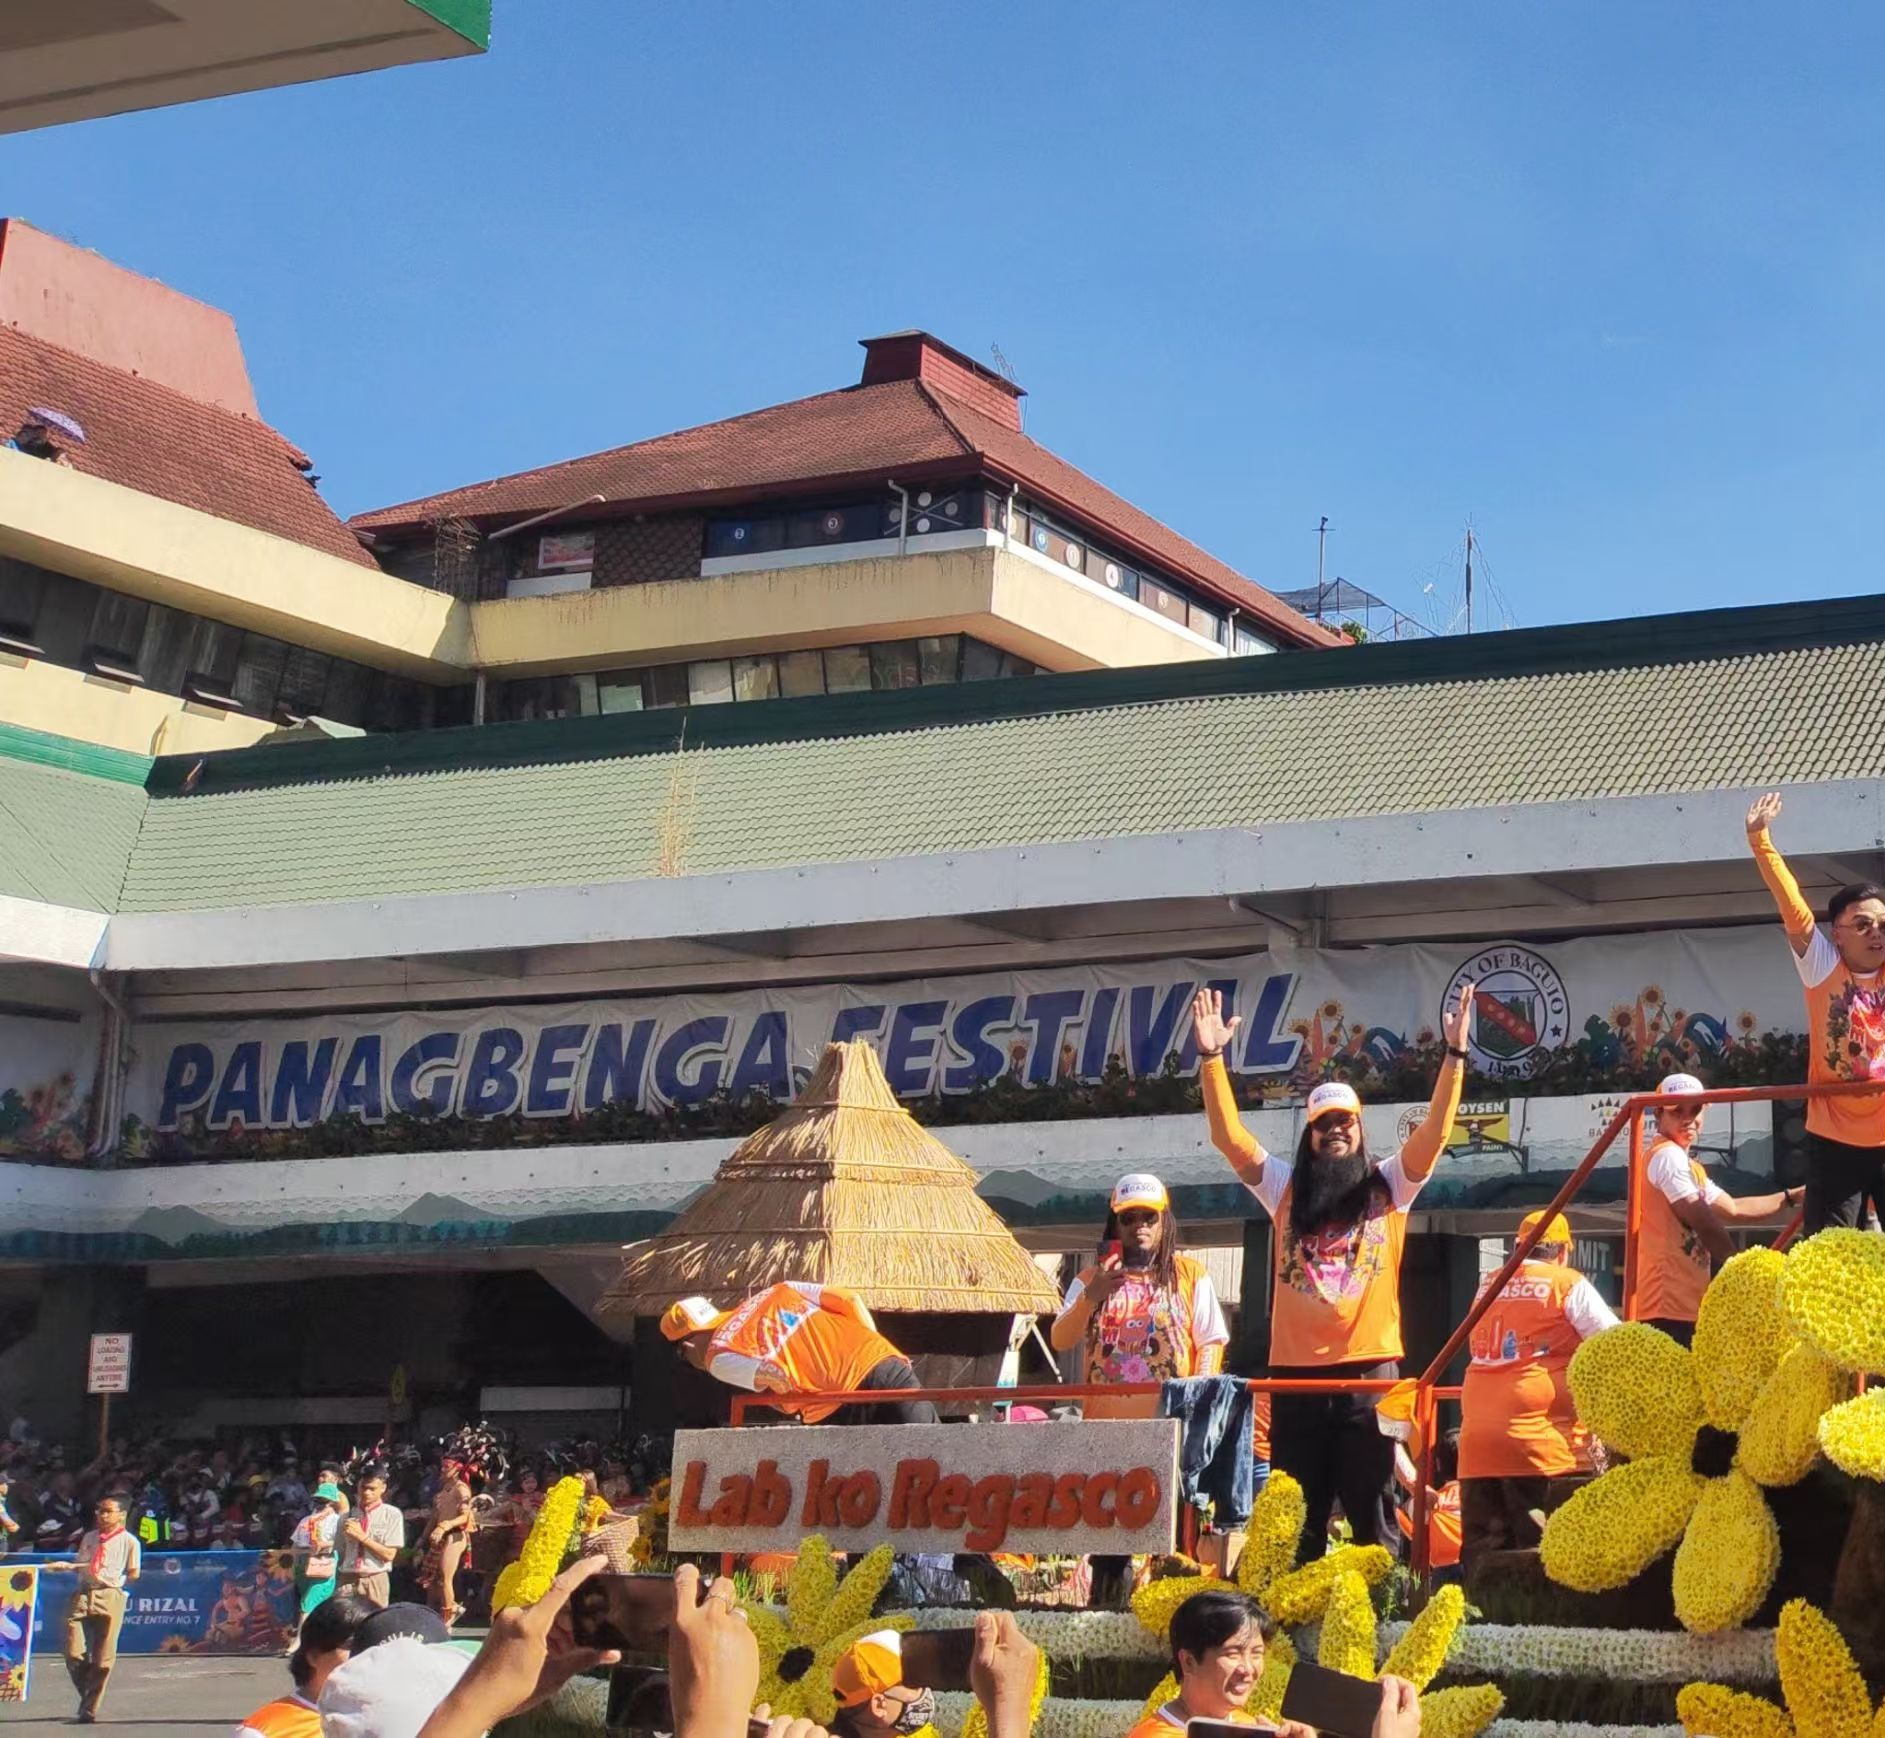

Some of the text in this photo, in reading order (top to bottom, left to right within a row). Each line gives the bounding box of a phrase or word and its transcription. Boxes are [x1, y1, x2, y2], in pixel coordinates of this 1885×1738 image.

[1478, 953, 1505, 974] OF
[1510, 952, 1564, 1015] BAGUIO
[157, 1010, 797, 1133] PANAGBENGA
[1457, 1102, 1505, 1114] OYSEN
[676, 1458, 1161, 1552] Lab ko Regasco
[138, 1598, 199, 1612] RIZAL
[144, 1615, 176, 1624] ENTRY
